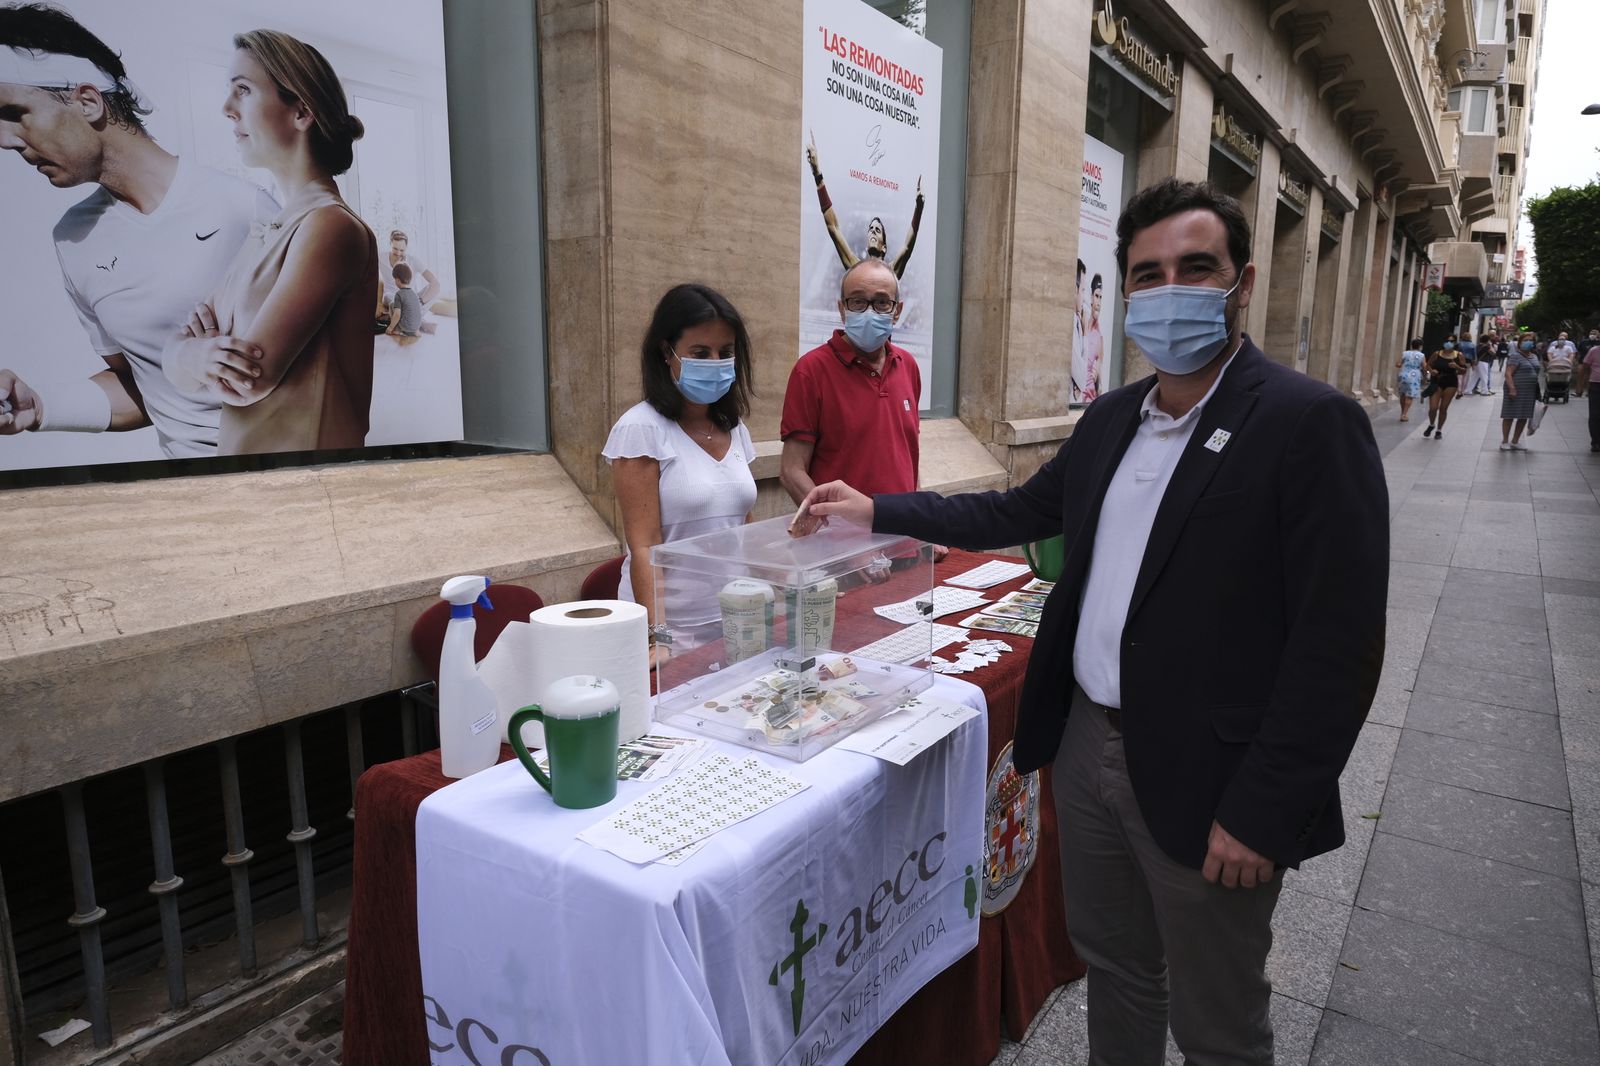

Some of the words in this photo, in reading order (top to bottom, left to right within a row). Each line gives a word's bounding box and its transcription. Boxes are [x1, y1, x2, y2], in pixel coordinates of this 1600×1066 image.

[850, 41, 924, 96] REMONTADAS
[1120, 16, 1180, 96] Santander
[827, 78, 844, 97] SON
[846, 86, 863, 105] UNA
[865, 94, 884, 114] COSA
[832, 59, 845, 77] NO
[847, 66, 863, 86] SON
[864, 74, 881, 96] UNA
[882, 83, 901, 102] COSA
[902, 92, 917, 110] MÍA.
[850, 168, 868, 183] VAMOS
[873, 177, 899, 192] REMONTAR
[1081, 177, 1101, 200] PYMES,
[835, 832, 947, 967] aecc
[800, 1029, 835, 1066] IDA,
[840, 948, 909, 1031] NUESTRA
[912, 917, 947, 957] VIDA
